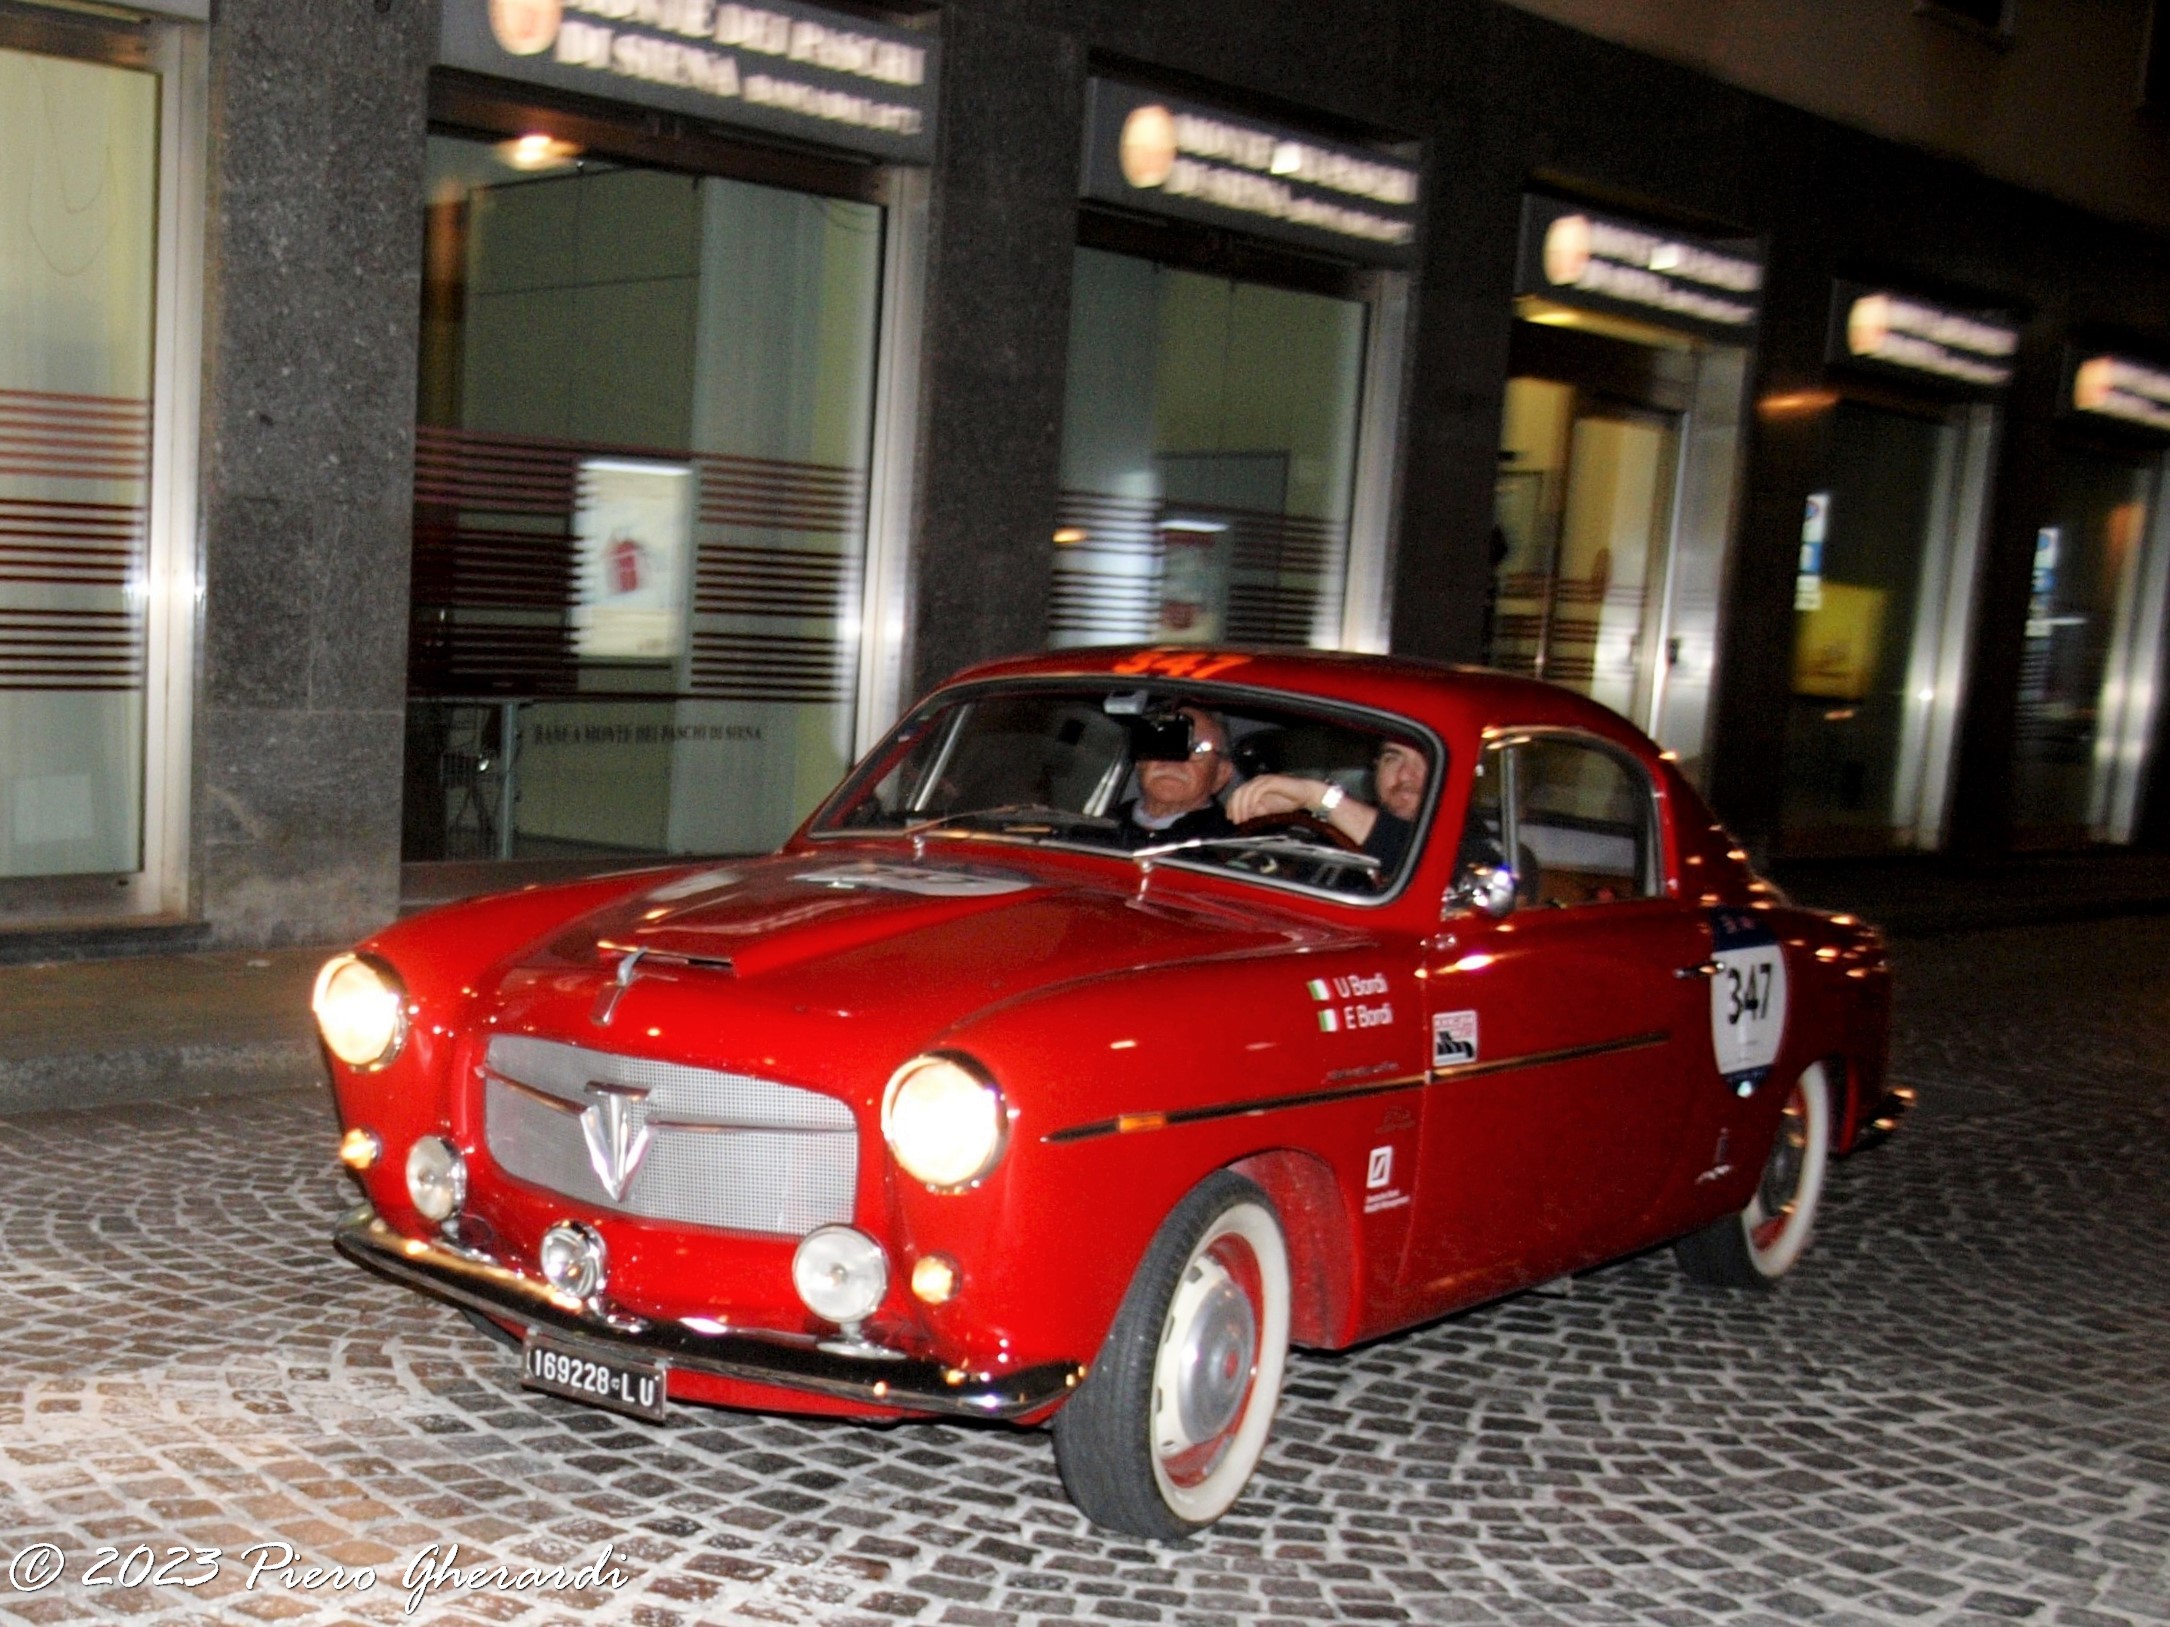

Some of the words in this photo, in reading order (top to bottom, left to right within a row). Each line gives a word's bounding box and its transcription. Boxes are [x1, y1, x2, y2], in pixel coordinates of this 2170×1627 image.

[1332, 976, 1351, 998] U
[1727, 962, 1772, 1026] 347
[1343, 1005, 1358, 1030] E
[535, 1349, 609, 1395] 169228
